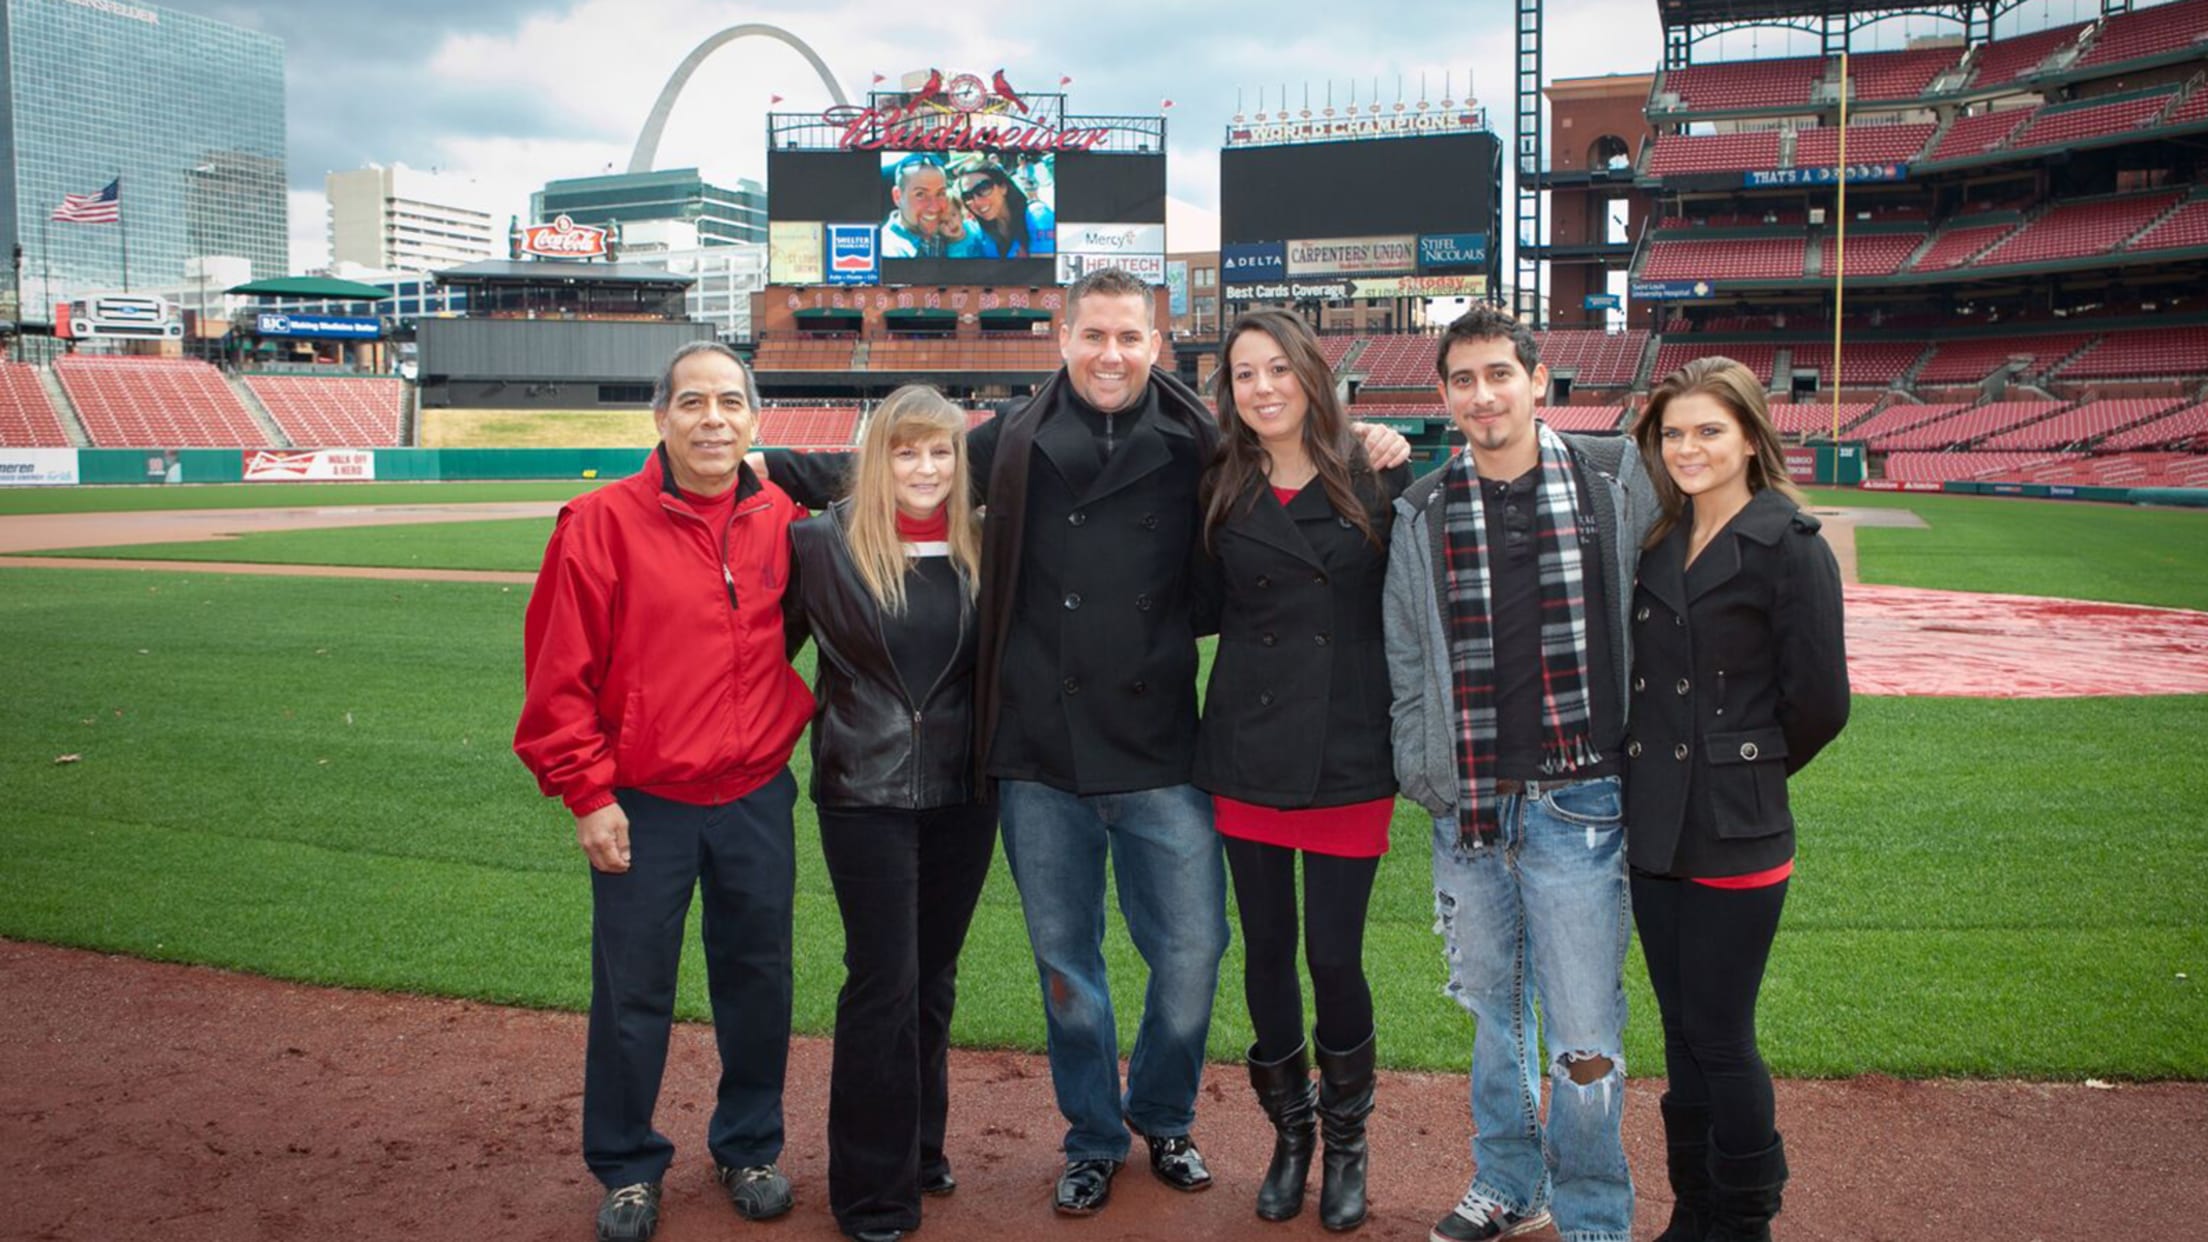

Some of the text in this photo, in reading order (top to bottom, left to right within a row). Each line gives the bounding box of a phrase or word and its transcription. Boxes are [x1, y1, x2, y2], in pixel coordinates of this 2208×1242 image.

[823, 105, 1108, 151] Budweiser
[1250, 114, 1461, 142] WORLD CHAMPIONS
[1802, 169, 1812, 183] A
[1085, 232, 1125, 249] Mercy
[1421, 238, 1456, 251] STIFEL
[1373, 242, 1413, 260] UNION
[1426, 247, 1486, 262] NICOLAUS
[1238, 255, 1283, 267] DELTA
[1226, 283, 1348, 301] Best Cards Coverage
[262, 317, 287, 330] BJC
